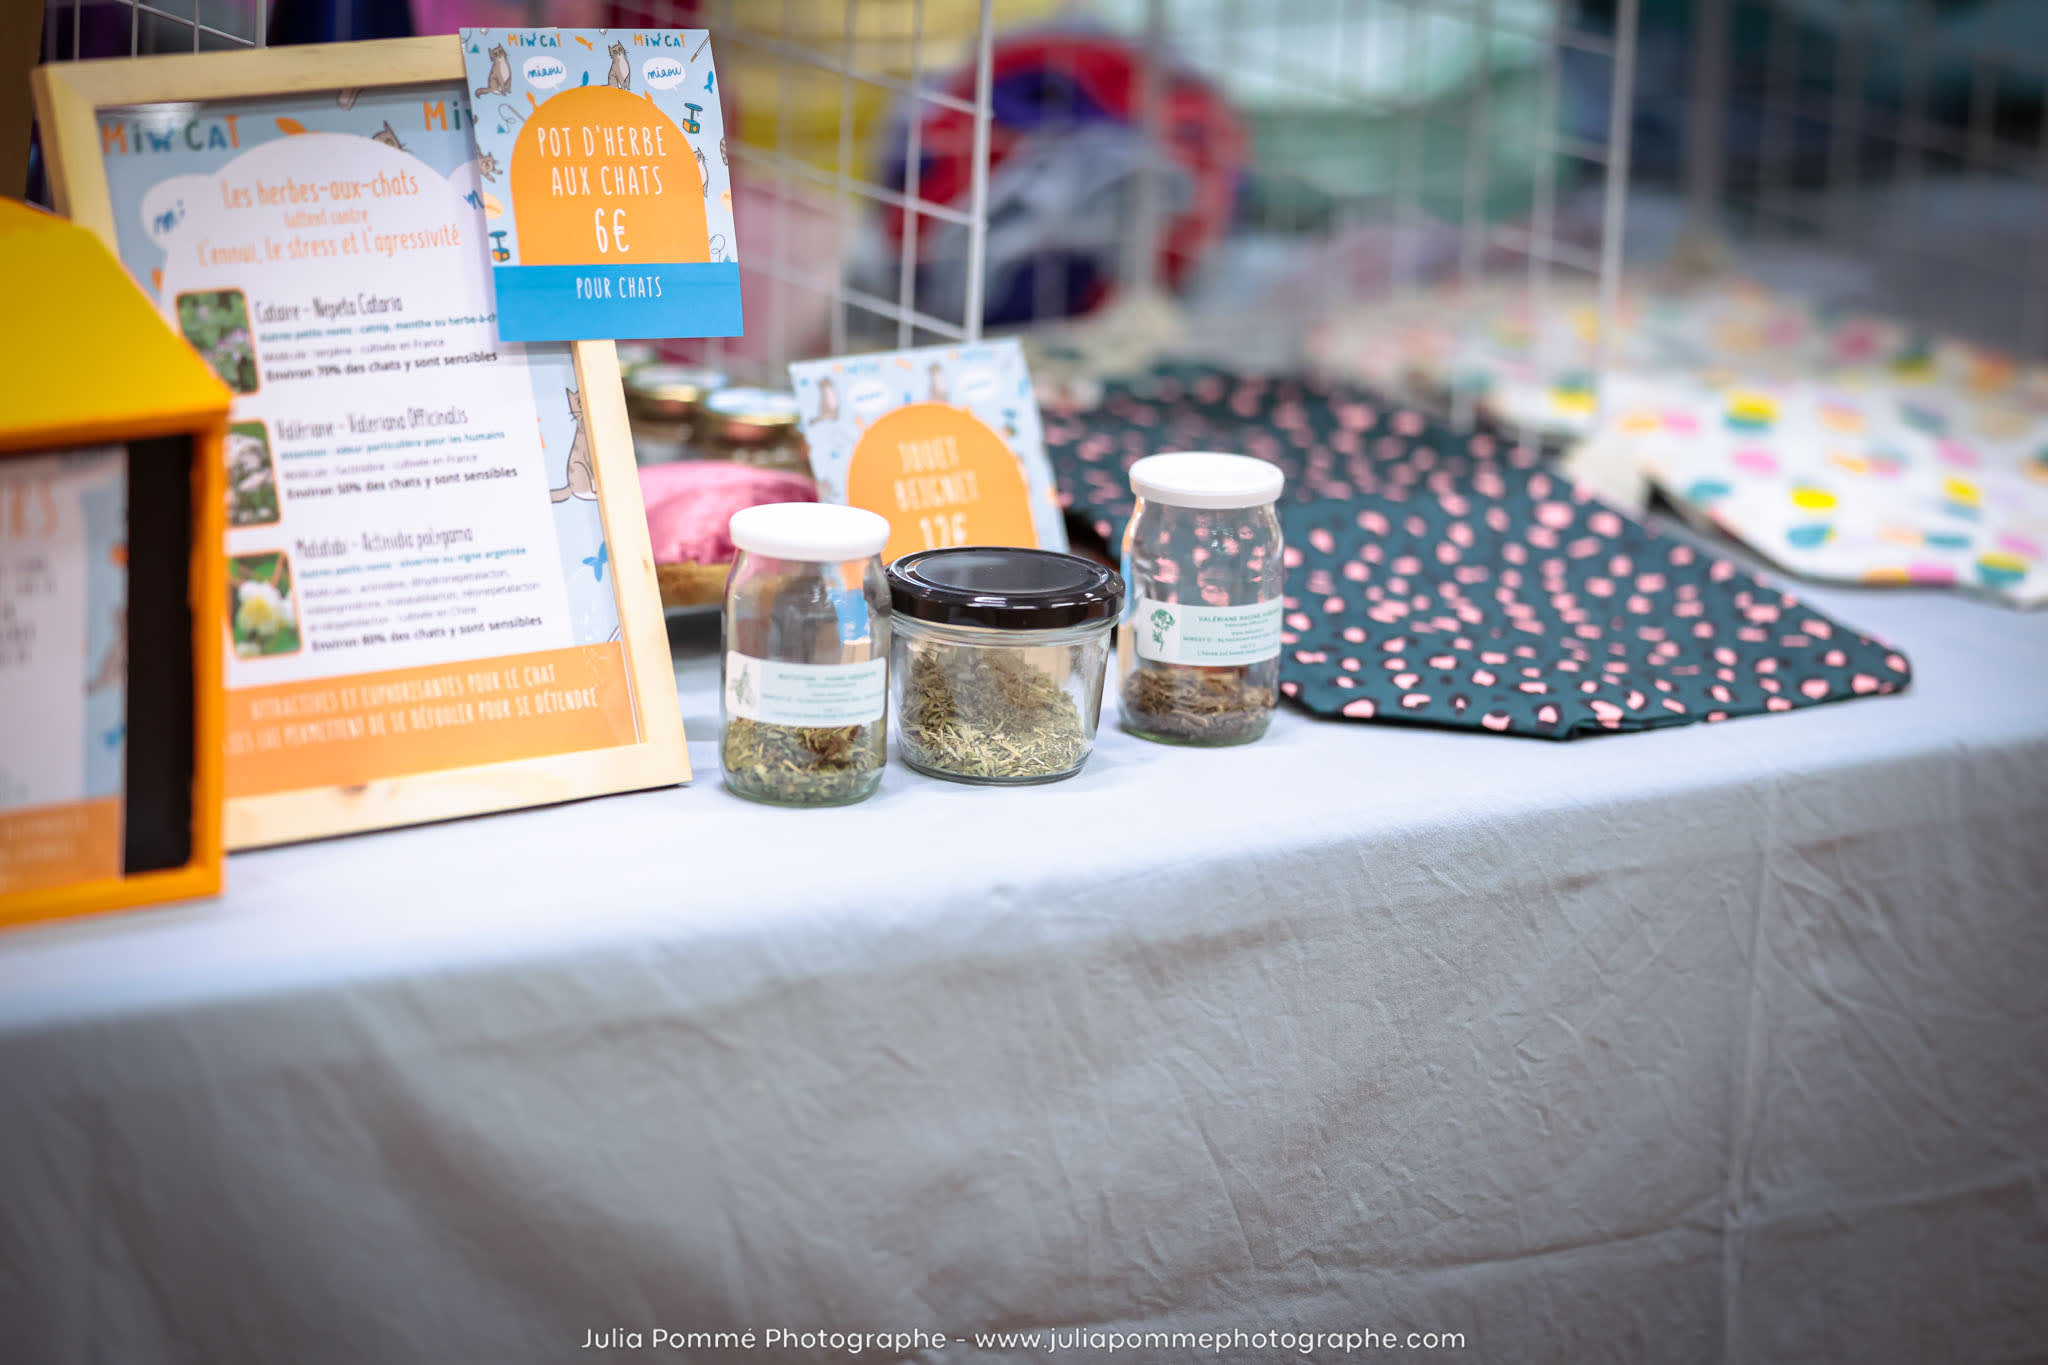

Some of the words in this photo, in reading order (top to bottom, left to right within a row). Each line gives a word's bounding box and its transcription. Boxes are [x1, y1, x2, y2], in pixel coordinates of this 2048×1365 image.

[527, 61, 565, 79] miaou
[647, 62, 684, 80] miaou
[537, 126, 573, 158] POT
[583, 125, 667, 157] D'HERBE
[551, 166, 591, 197] AUX
[600, 165, 663, 197] CHATS
[287, 234, 338, 260] stress
[341, 231, 359, 256] et
[594, 207, 630, 254] 6€
[576, 276, 612, 300] POUR
[619, 276, 662, 298] CHATS
[369, 359, 402, 373] chats
[415, 356, 441, 370] sont
[444, 350, 498, 367] sensibles
[898, 435, 960, 474] JOUET
[388, 476, 422, 490] chats
[435, 472, 461, 486] sont
[464, 466, 518, 483] sensibles
[894, 468, 980, 513] BEIGNET
[459, 622, 485, 636] sont
[489, 615, 543, 632] sensibles
[467, 670, 500, 694] POUR
[504, 666, 520, 689] LE
[523, 663, 556, 687] CHAT
[478, 698, 511, 721] POUR
[515, 695, 532, 717] SE
[535, 686, 599, 715] DÉTENDRE
